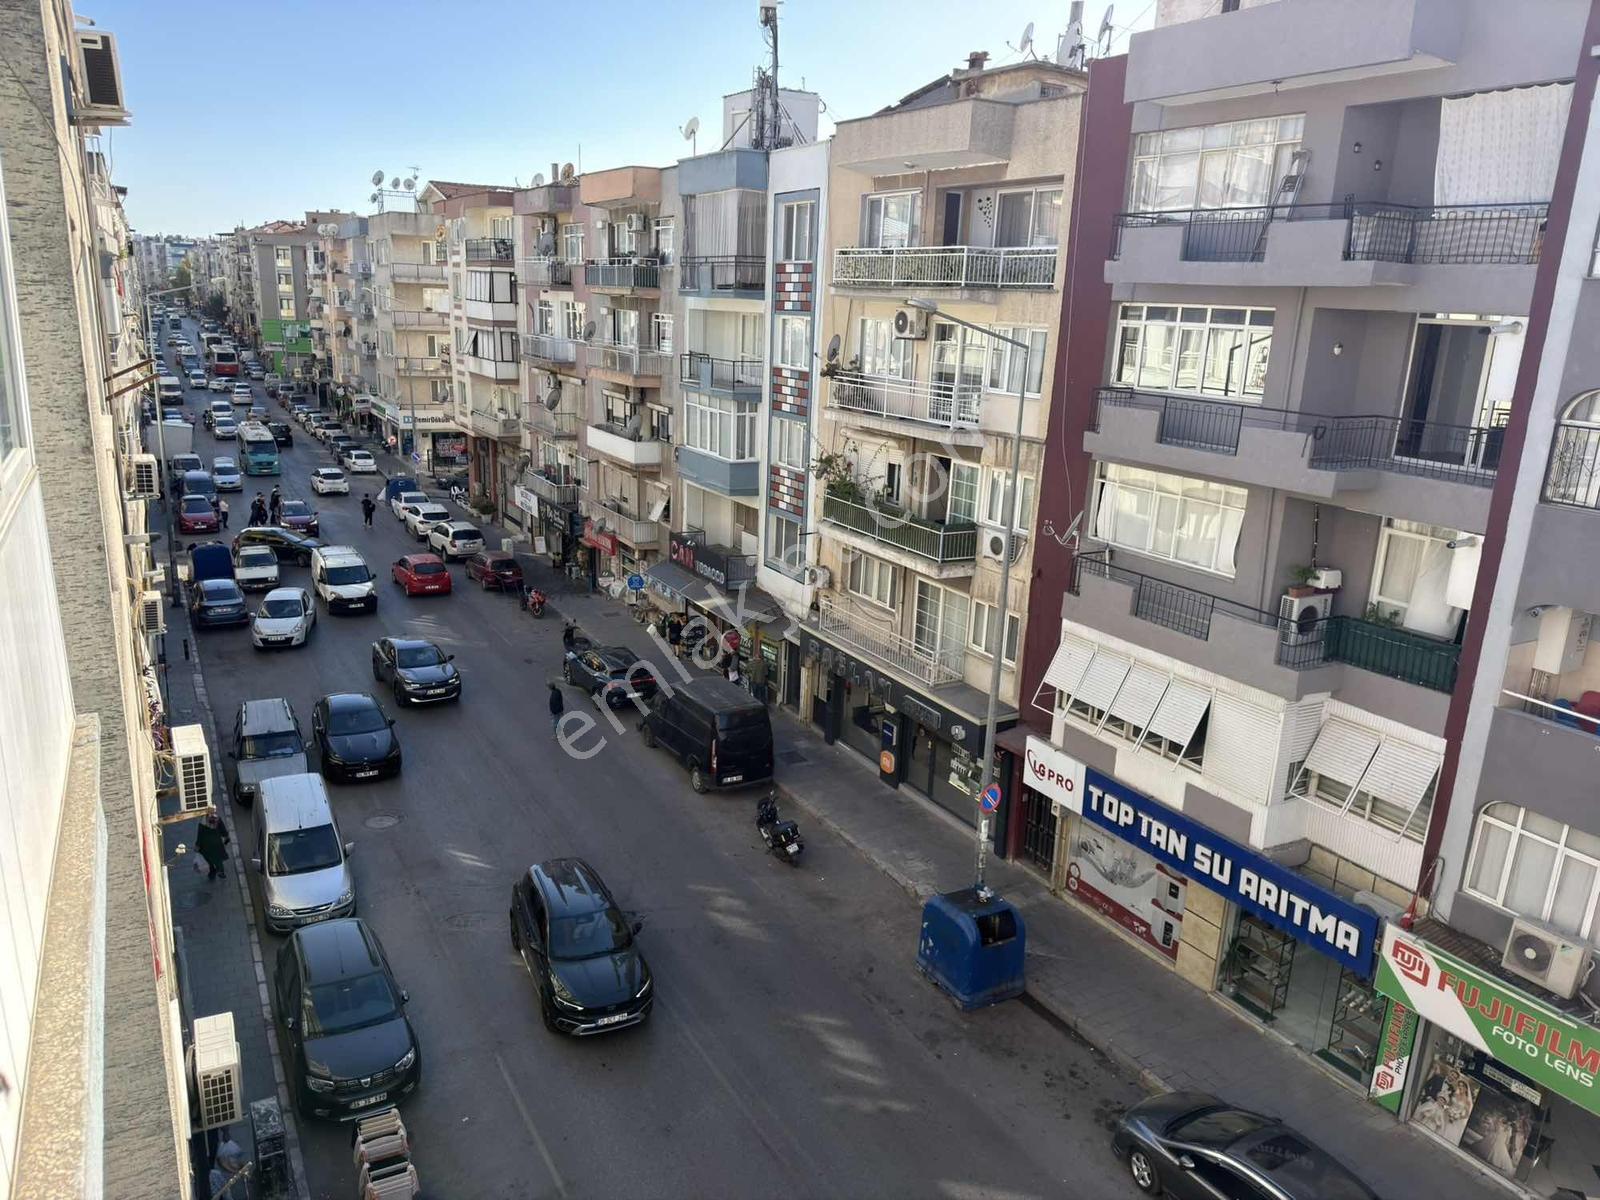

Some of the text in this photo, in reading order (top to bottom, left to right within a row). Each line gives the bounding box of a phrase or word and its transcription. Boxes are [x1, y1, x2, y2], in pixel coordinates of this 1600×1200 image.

[1047, 768, 1074, 792] PRO
[1193, 842, 1233, 886] SU
[1238, 867, 1360, 959] ARITMA
[1437, 970, 1600, 1076] FUJIFILM
[1492, 1025, 1539, 1058] FOTO
[1544, 1053, 1594, 1088] LENS
